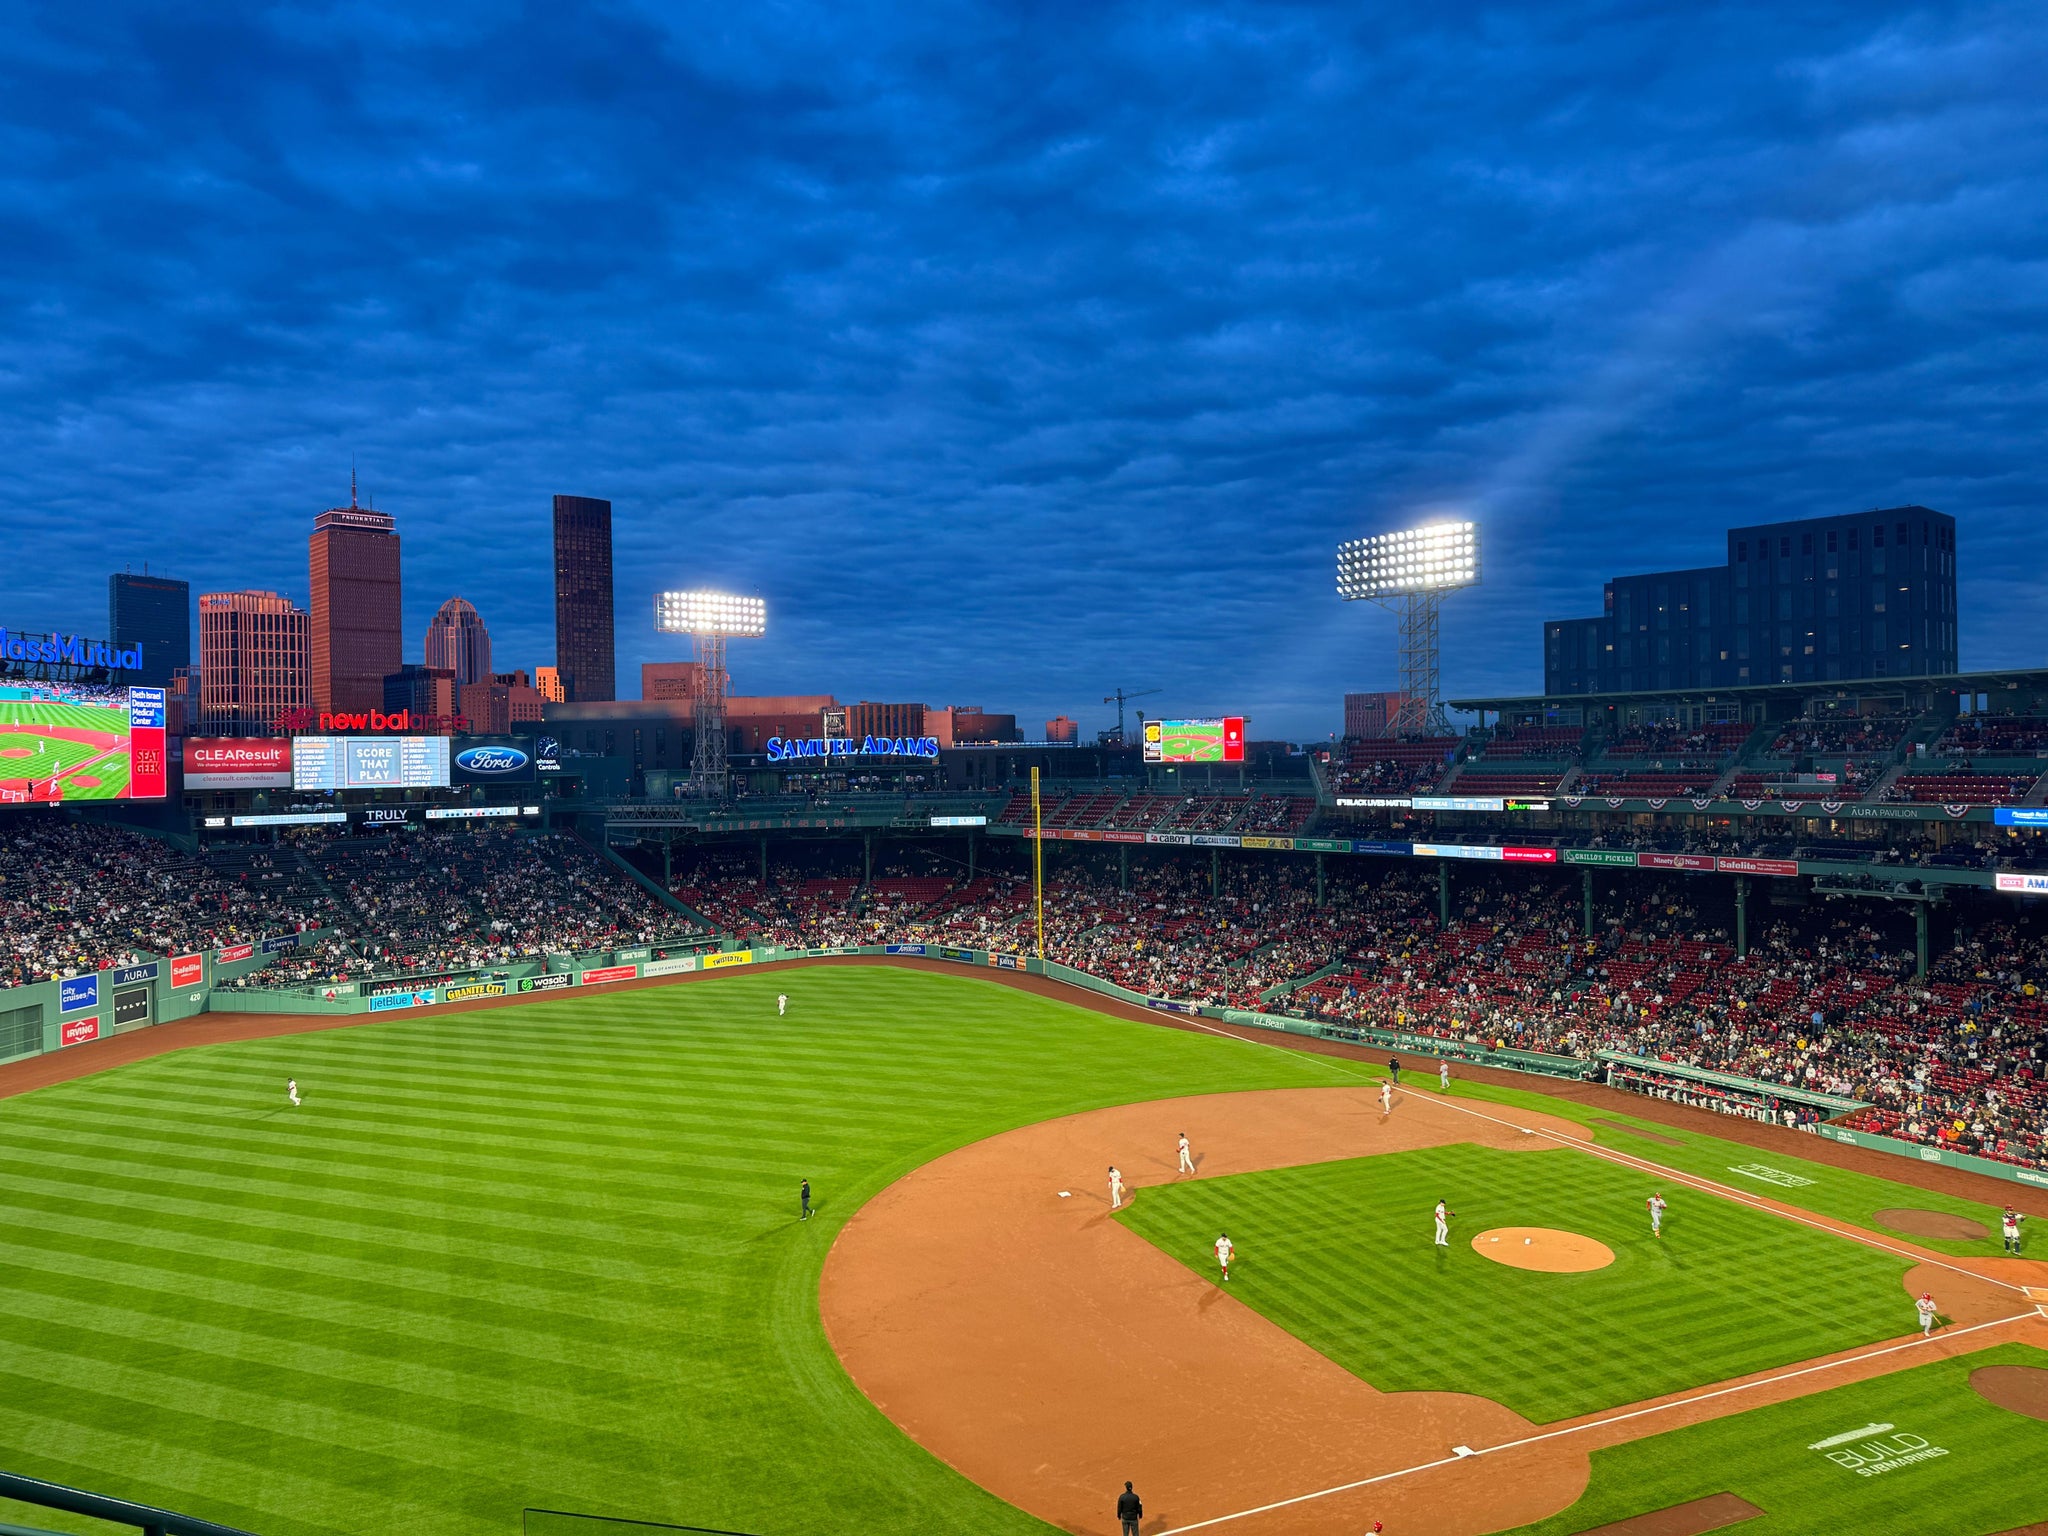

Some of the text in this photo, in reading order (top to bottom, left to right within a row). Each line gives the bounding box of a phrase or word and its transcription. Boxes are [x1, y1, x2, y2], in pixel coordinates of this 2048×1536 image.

[341, 514, 385, 523] PRUDENTIAL
[0, 627, 143, 670] assMutual
[131, 691, 161, 700] Beth Israel
[132, 700, 162, 709] Deaconess
[132, 708, 155, 717] Medical
[132, 717, 152, 725] Center
[319, 712, 368, 730] new
[356, 749, 392, 757] SCORE
[767, 734, 939, 761] SAMUEL ADAMS
[137, 750, 160, 761] SEAT
[194, 749, 281, 762] CLEAResult
[470, 750, 514, 768] Ford
[136, 763, 160, 774] GEEK
[360, 760, 388, 768] THAT
[202, 775, 274, 783] clearesult.com/redsox
[359, 771, 389, 780] PLAY
[365, 809, 408, 820] TRULY
[1879, 809, 1918, 821] PAVILION
[1605, 855, 1634, 863] PICKLES
[1653, 857, 1674, 866] Ninety
[1684, 858, 1700, 867] Nine
[1720, 860, 1756, 871] Safelite
[232, 947, 253, 958] TICKET
[712, 955, 743, 966] TWISTED TEA
[173, 963, 200, 975] Safelite
[534, 974, 568, 987] wasabi
[62, 987, 76, 997] city
[447, 984, 485, 1000] GRANITE
[486, 982, 505, 995] CITY
[62, 993, 87, 1003] cruises
[189, 992, 201, 1002] 420
[373, 995, 408, 1010] jetBlue
[115, 1000, 147, 1012] VOLVO
[1252, 1016, 1285, 1030] L.L.Bean
[66, 1024, 94, 1038] IRVING
[1823, 1432, 1930, 1469] BUILD
[1854, 1446, 1951, 1478] SUBMARINES
